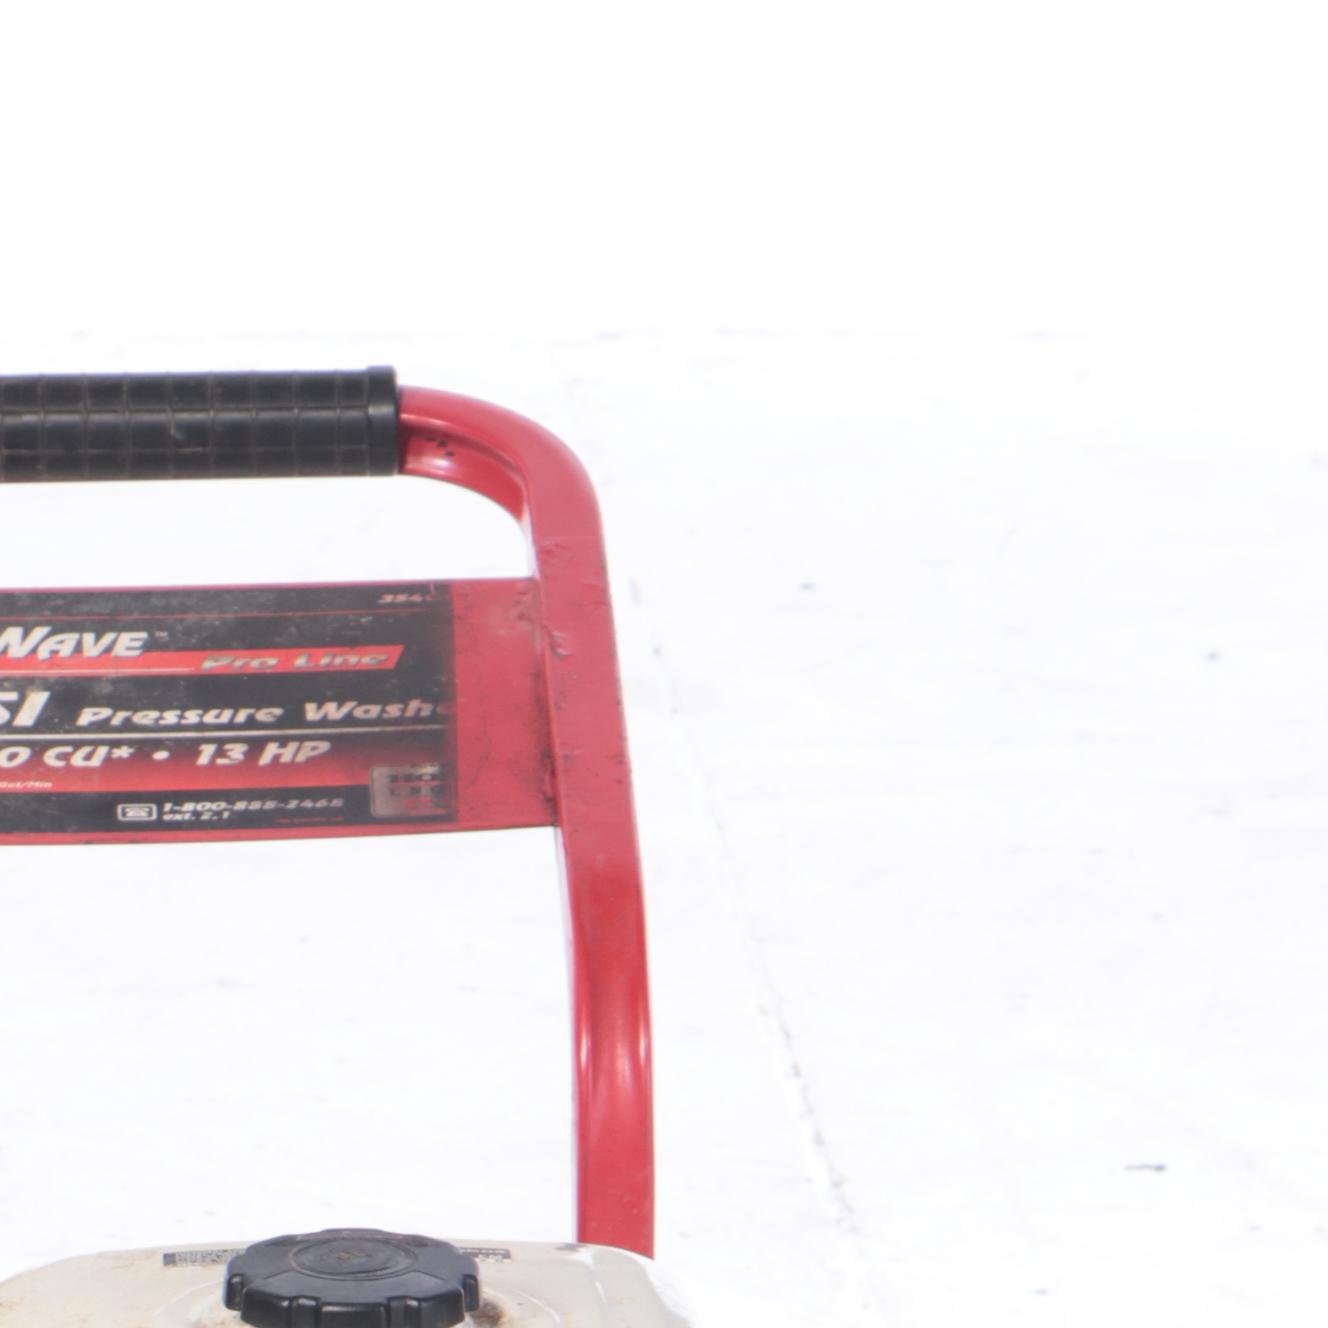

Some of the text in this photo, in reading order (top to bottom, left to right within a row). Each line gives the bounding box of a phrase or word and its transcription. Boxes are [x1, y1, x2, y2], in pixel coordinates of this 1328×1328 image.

[199, 652, 389, 672] Pro Line
[75, 706, 284, 727] Pressure
[195, 742, 250, 766] 13
[257, 740, 331, 766] HP
